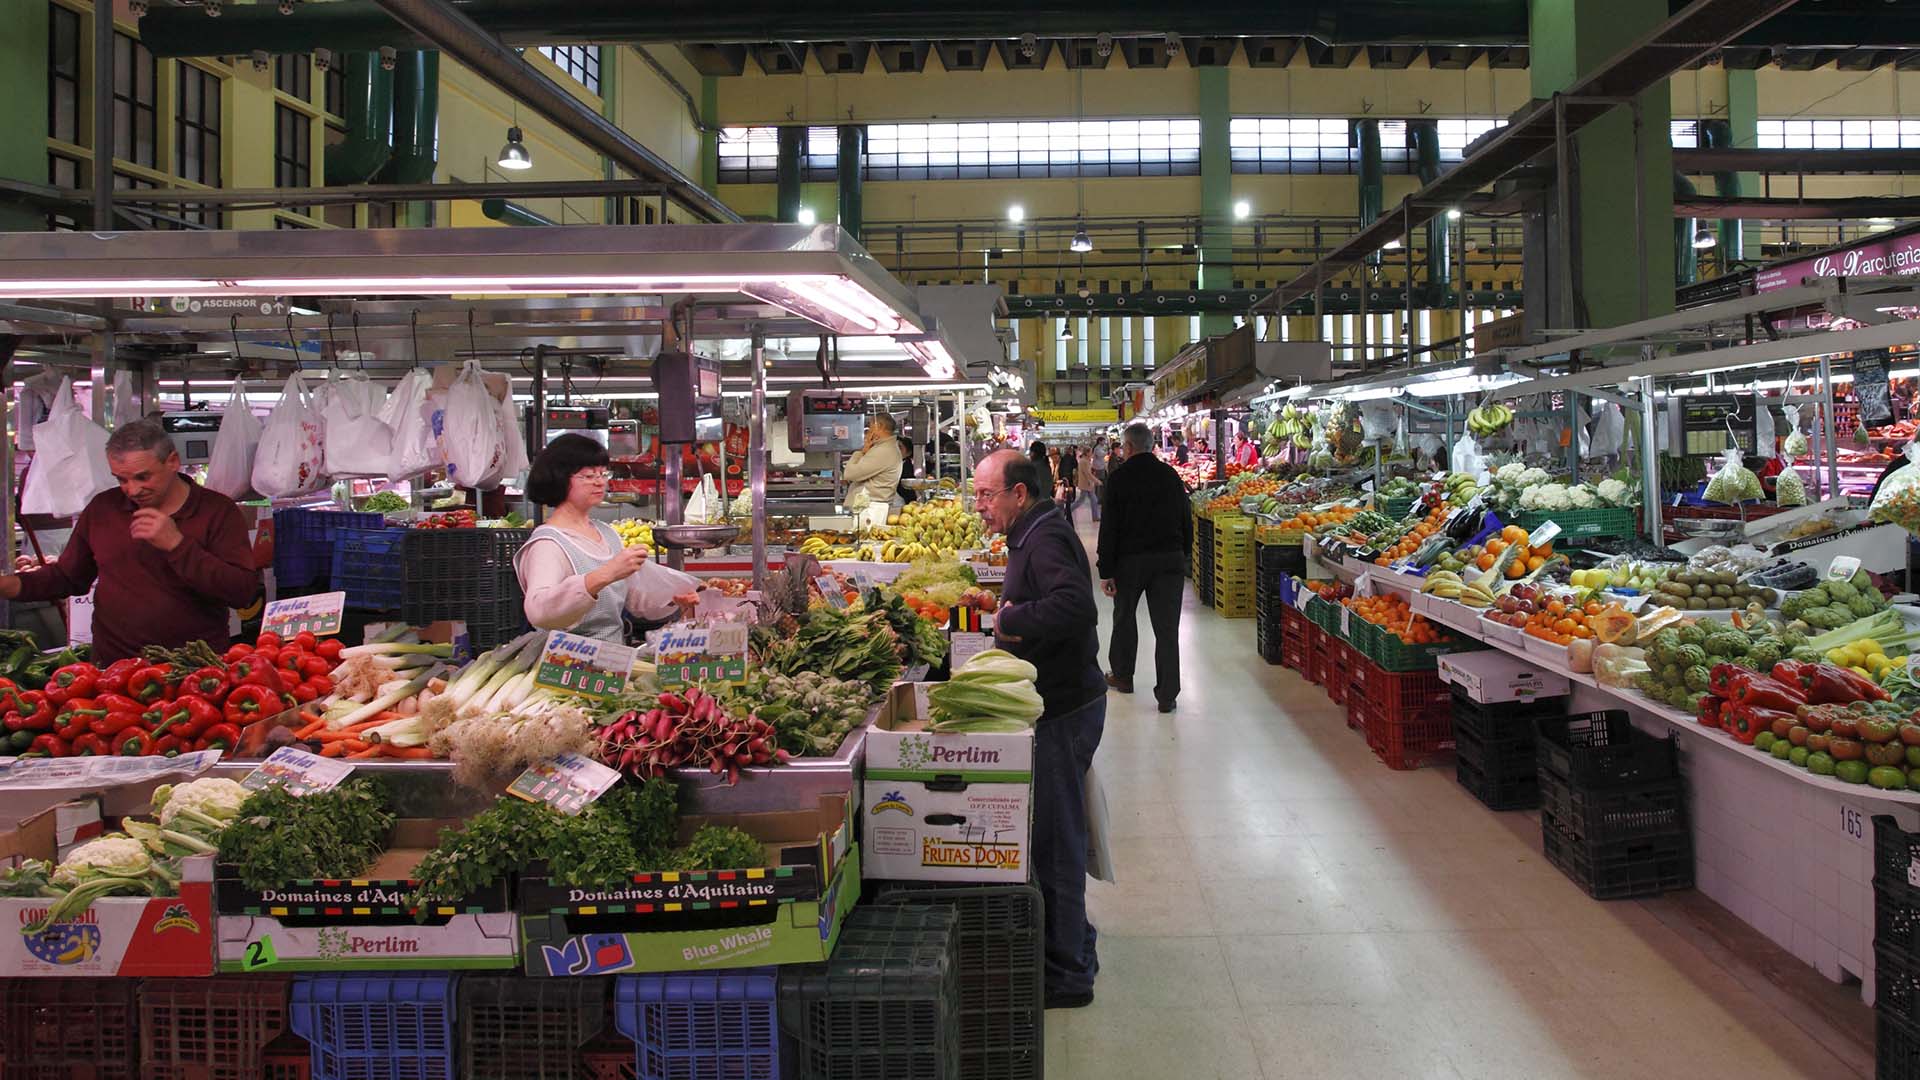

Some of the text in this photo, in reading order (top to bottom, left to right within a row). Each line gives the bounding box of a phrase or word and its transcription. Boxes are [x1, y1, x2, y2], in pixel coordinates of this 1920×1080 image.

[203, 300, 257, 308] ASCENSOR
[1788, 535, 1835, 549] Domaines
[549, 633, 598, 656] Frutas
[659, 633, 707, 652] Frutas
[932, 745, 1001, 763] Perlim
[1841, 806, 1862, 839] 165
[922, 845, 971, 864] FRUTAS
[262, 889, 352, 903] Domaines
[569, 880, 775, 902] Domaines d'Aquitaine
[246, 940, 268, 966] 2
[351, 936, 419, 953] Perlim
[682, 945, 719, 961] Blue
[719, 928, 773, 950] Whale
